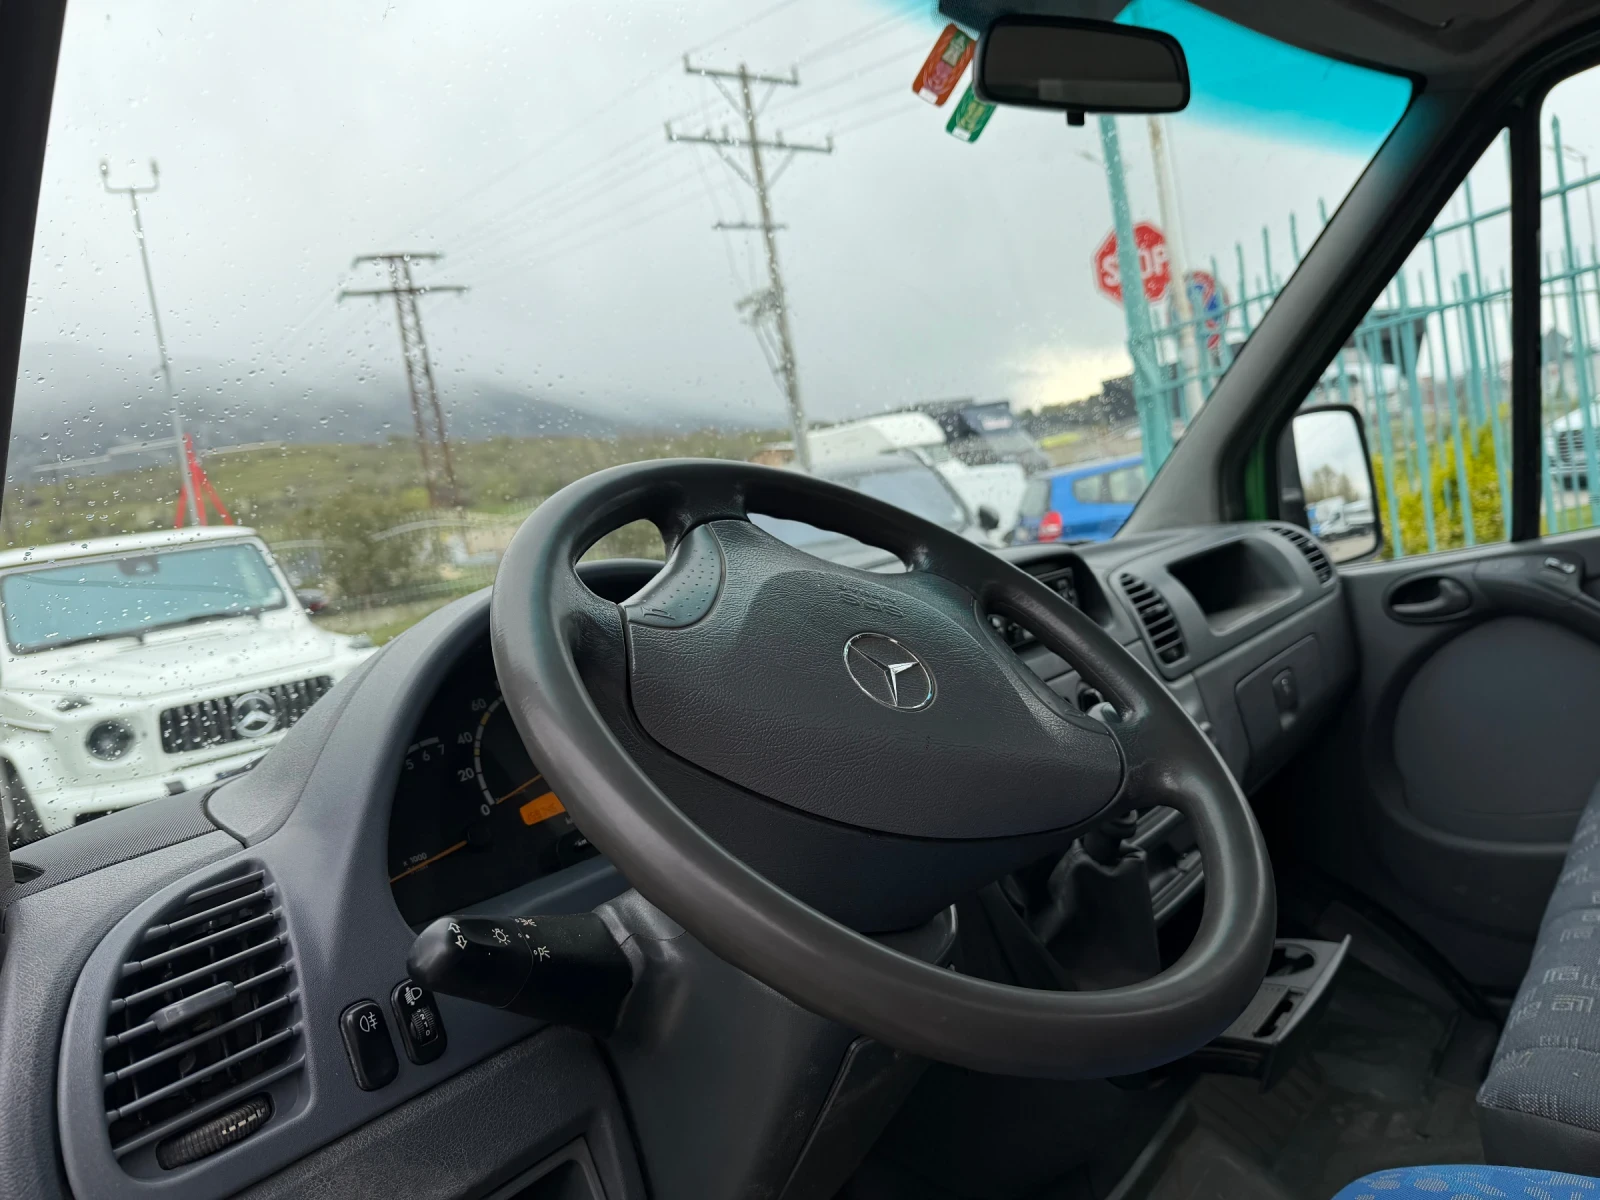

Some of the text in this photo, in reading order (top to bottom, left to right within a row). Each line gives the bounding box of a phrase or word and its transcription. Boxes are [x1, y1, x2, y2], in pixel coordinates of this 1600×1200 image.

[1101, 243, 1169, 287] SOP
[471, 697, 487, 711] 60
[457, 731, 473, 745] 40
[405, 743, 445, 770] 5 6 7
[457, 767, 475, 782] 20
[480, 803, 491, 816] 0
[409, 852, 428, 863] 1000
